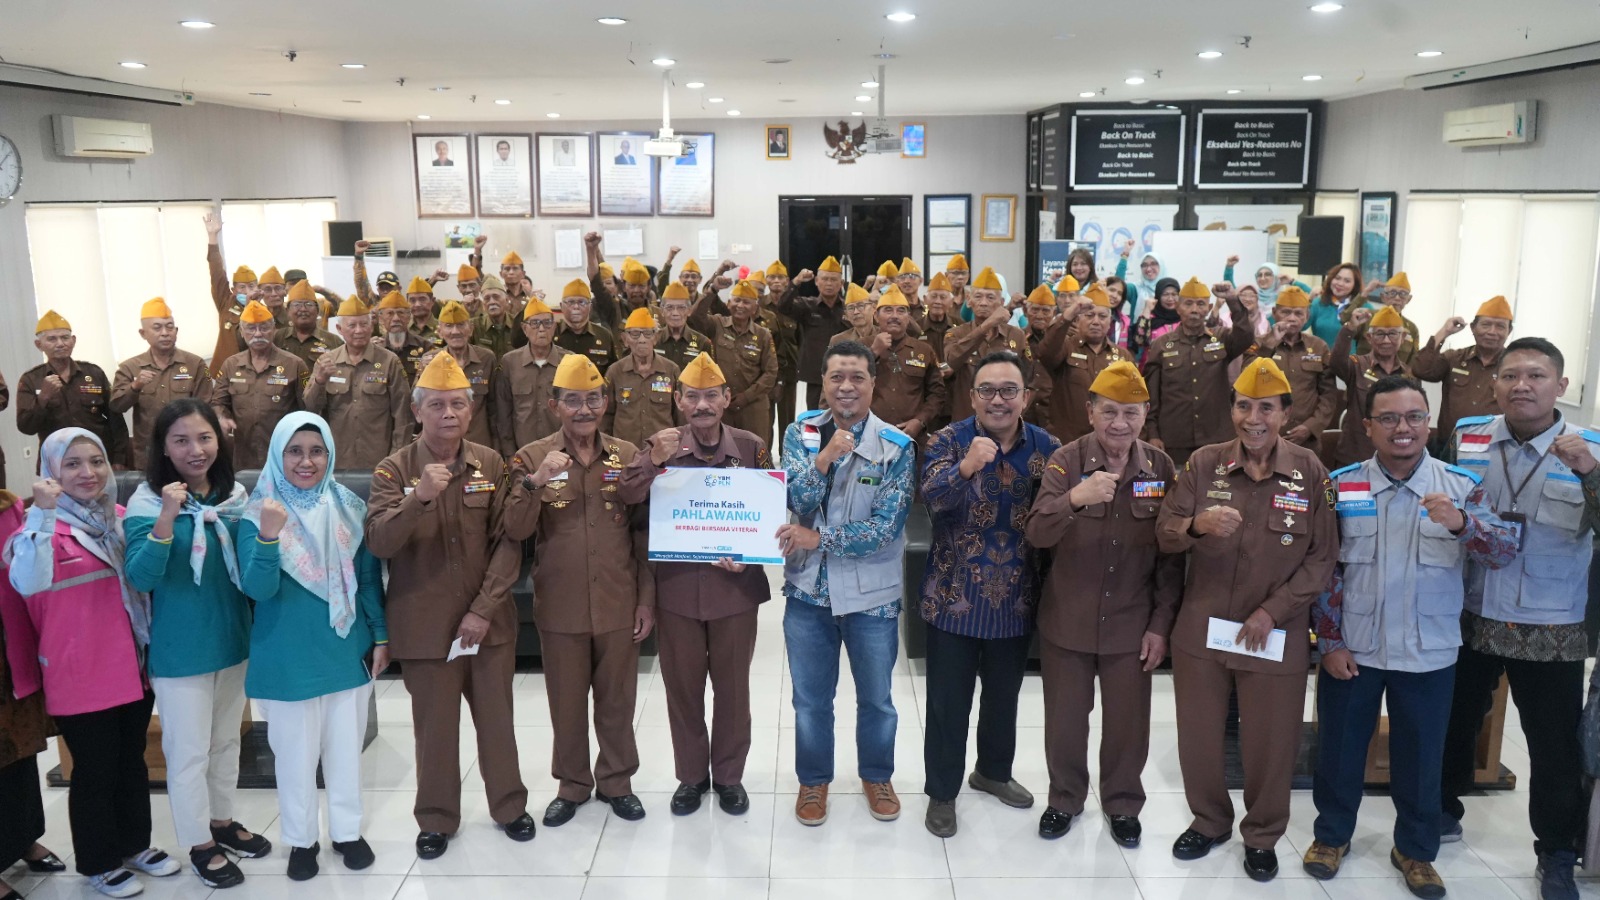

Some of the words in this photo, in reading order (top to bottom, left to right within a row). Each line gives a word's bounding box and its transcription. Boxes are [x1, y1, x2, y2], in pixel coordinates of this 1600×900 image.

[1101, 131, 1120, 139] Back
[1122, 131, 1133, 139] On
[1135, 131, 1156, 139] Track
[1206, 140, 1240, 148] Eksekusi
[1242, 140, 1289, 148] Yes-Reasons
[1290, 140, 1302, 148] No
[689, 500, 719, 508] Terima
[721, 500, 744, 509] Kasih
[672, 509, 761, 522] PAHLAWANKU
